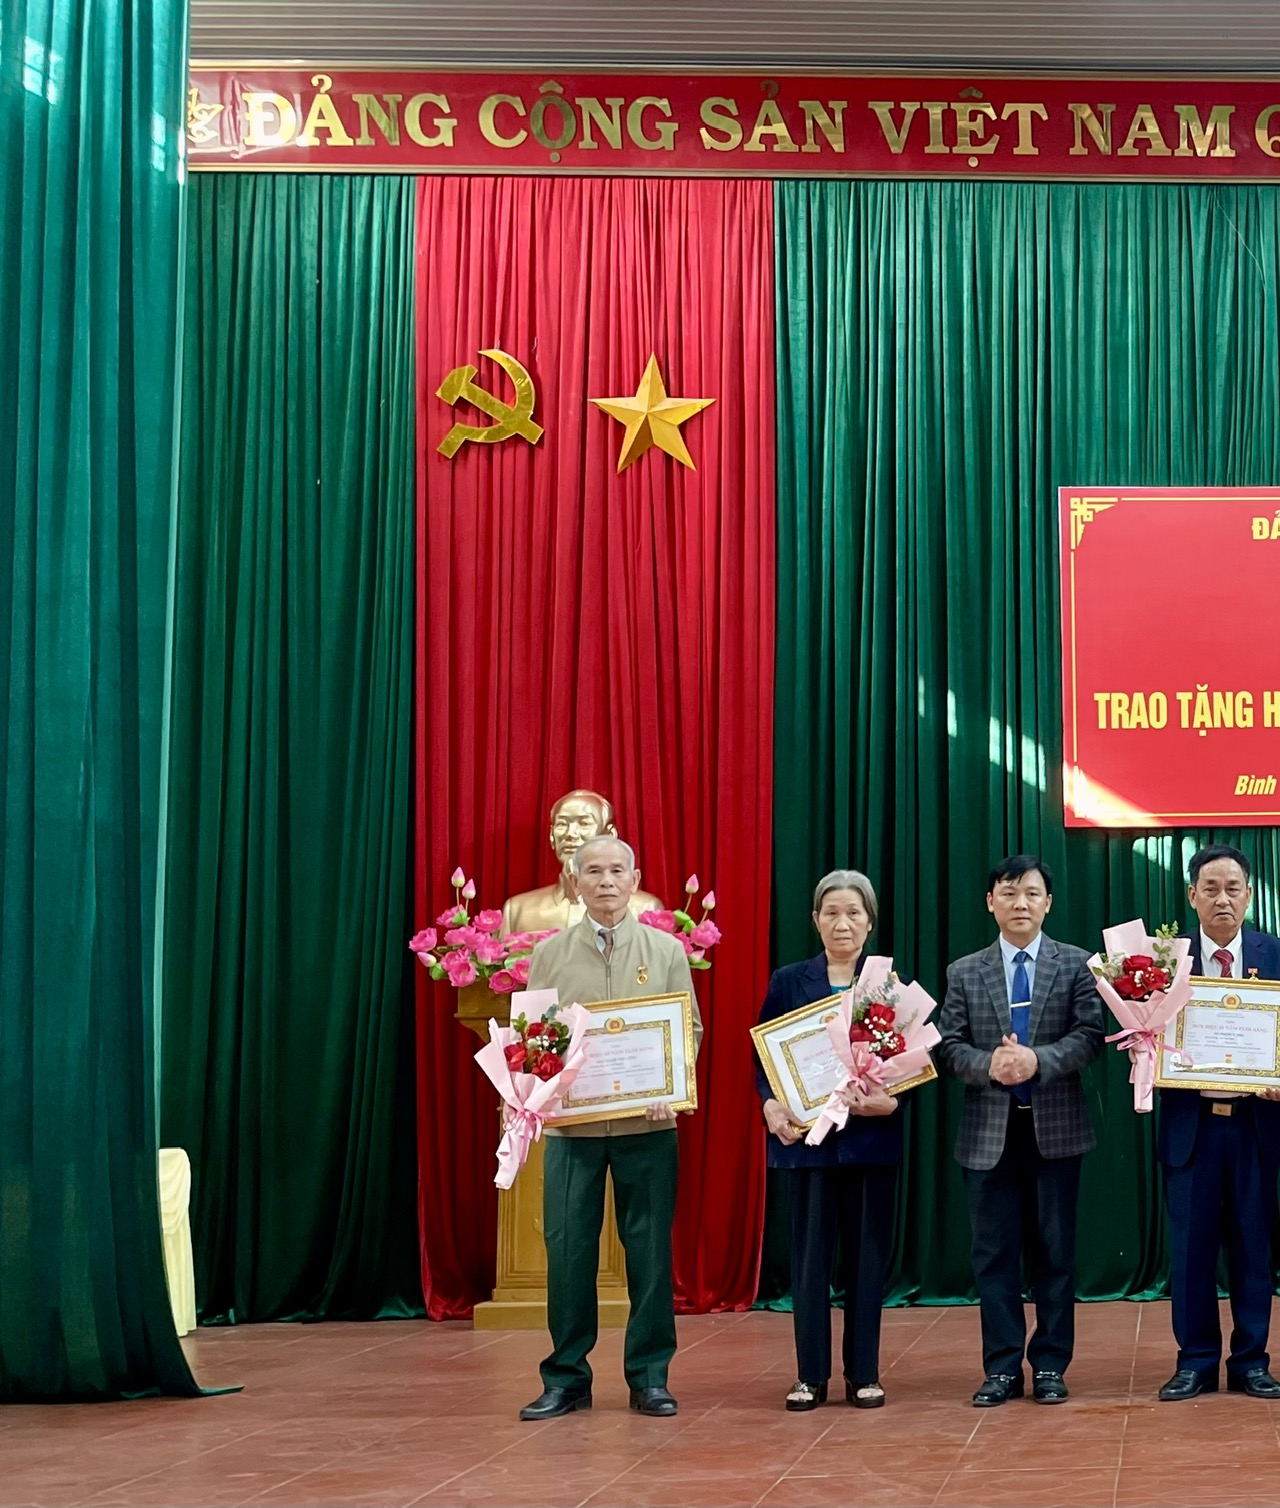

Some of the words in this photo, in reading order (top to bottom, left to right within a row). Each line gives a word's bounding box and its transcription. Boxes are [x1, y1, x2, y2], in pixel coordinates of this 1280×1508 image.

[243, 75, 457, 148] ĐẢNG
[478, 80, 680, 163] CỘNG
[699, 80, 848, 153] SẢN
[868, 87, 1049, 167] VIỆT
[1068, 103, 1237, 158] NAM
[1093, 691, 1168, 730] TRAO
[1176, 684, 1255, 737] TẶNG
[1234, 774, 1278, 796] Bình
